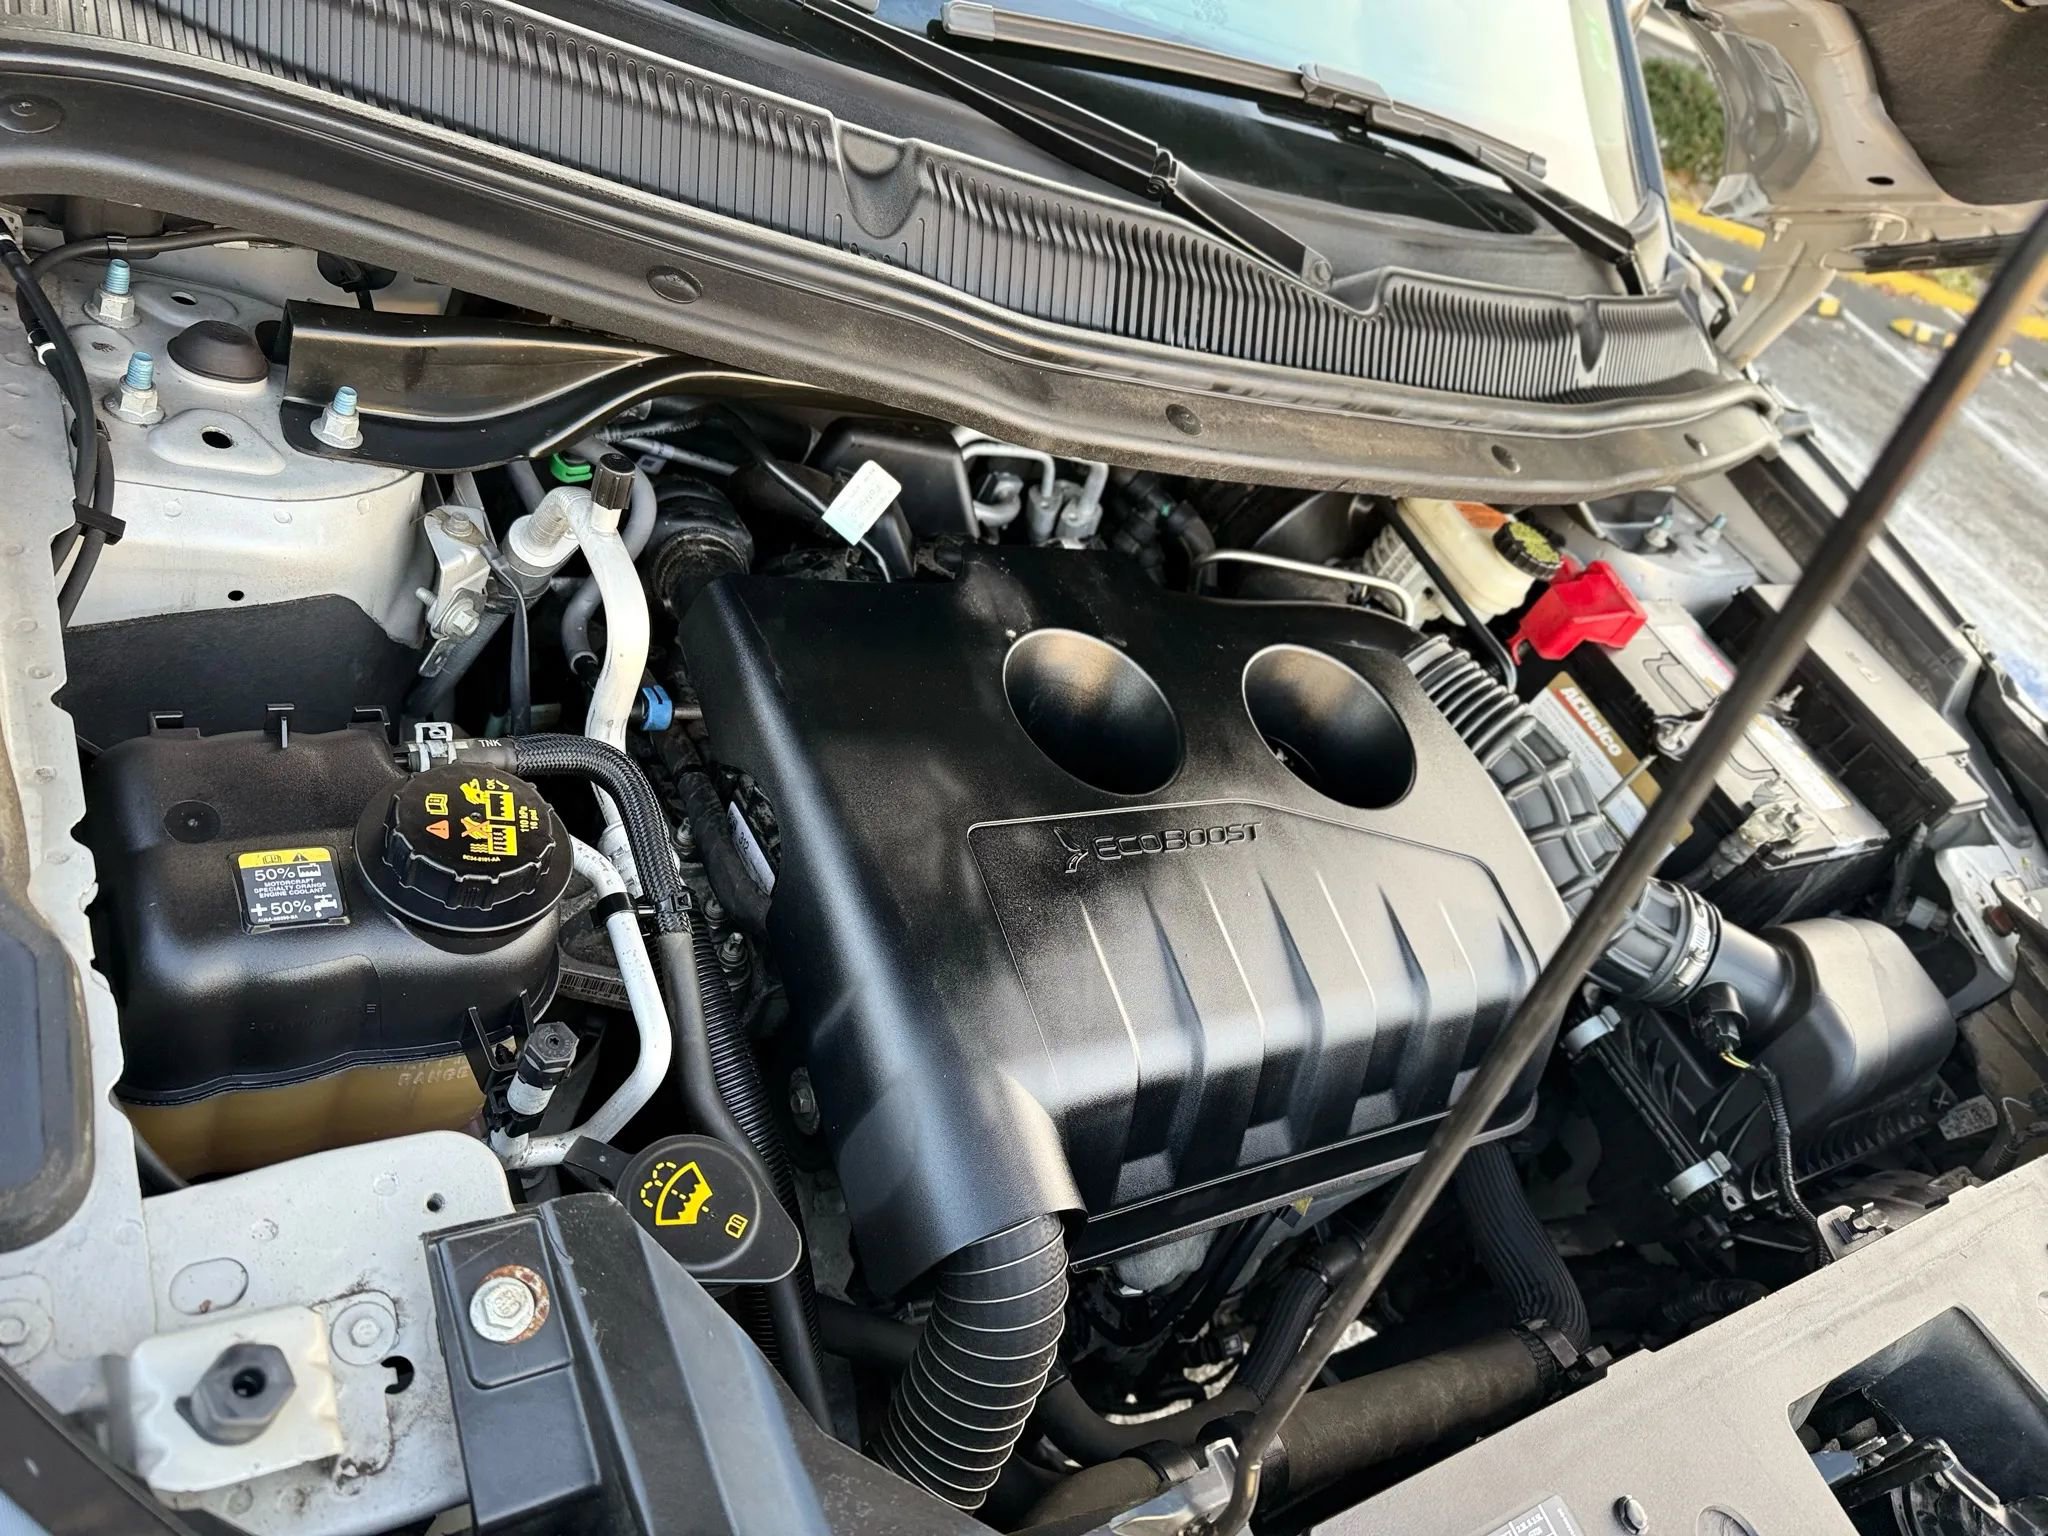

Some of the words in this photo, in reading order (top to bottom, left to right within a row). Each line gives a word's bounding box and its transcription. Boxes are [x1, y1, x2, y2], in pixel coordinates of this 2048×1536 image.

[1559, 687, 1622, 757] ACDelco
[478, 739, 502, 748] TNK
[486, 779, 495, 790] OK
[520, 820, 530, 833] 110
[255, 867, 295, 882] 50%
[253, 886, 293, 894] SPECIALTY
[295, 882, 327, 890] ORANGE
[264, 878, 315, 888] MOTORCRAFT
[259, 890, 288, 899] ENGINE
[289, 887, 324, 896] COOLANT
